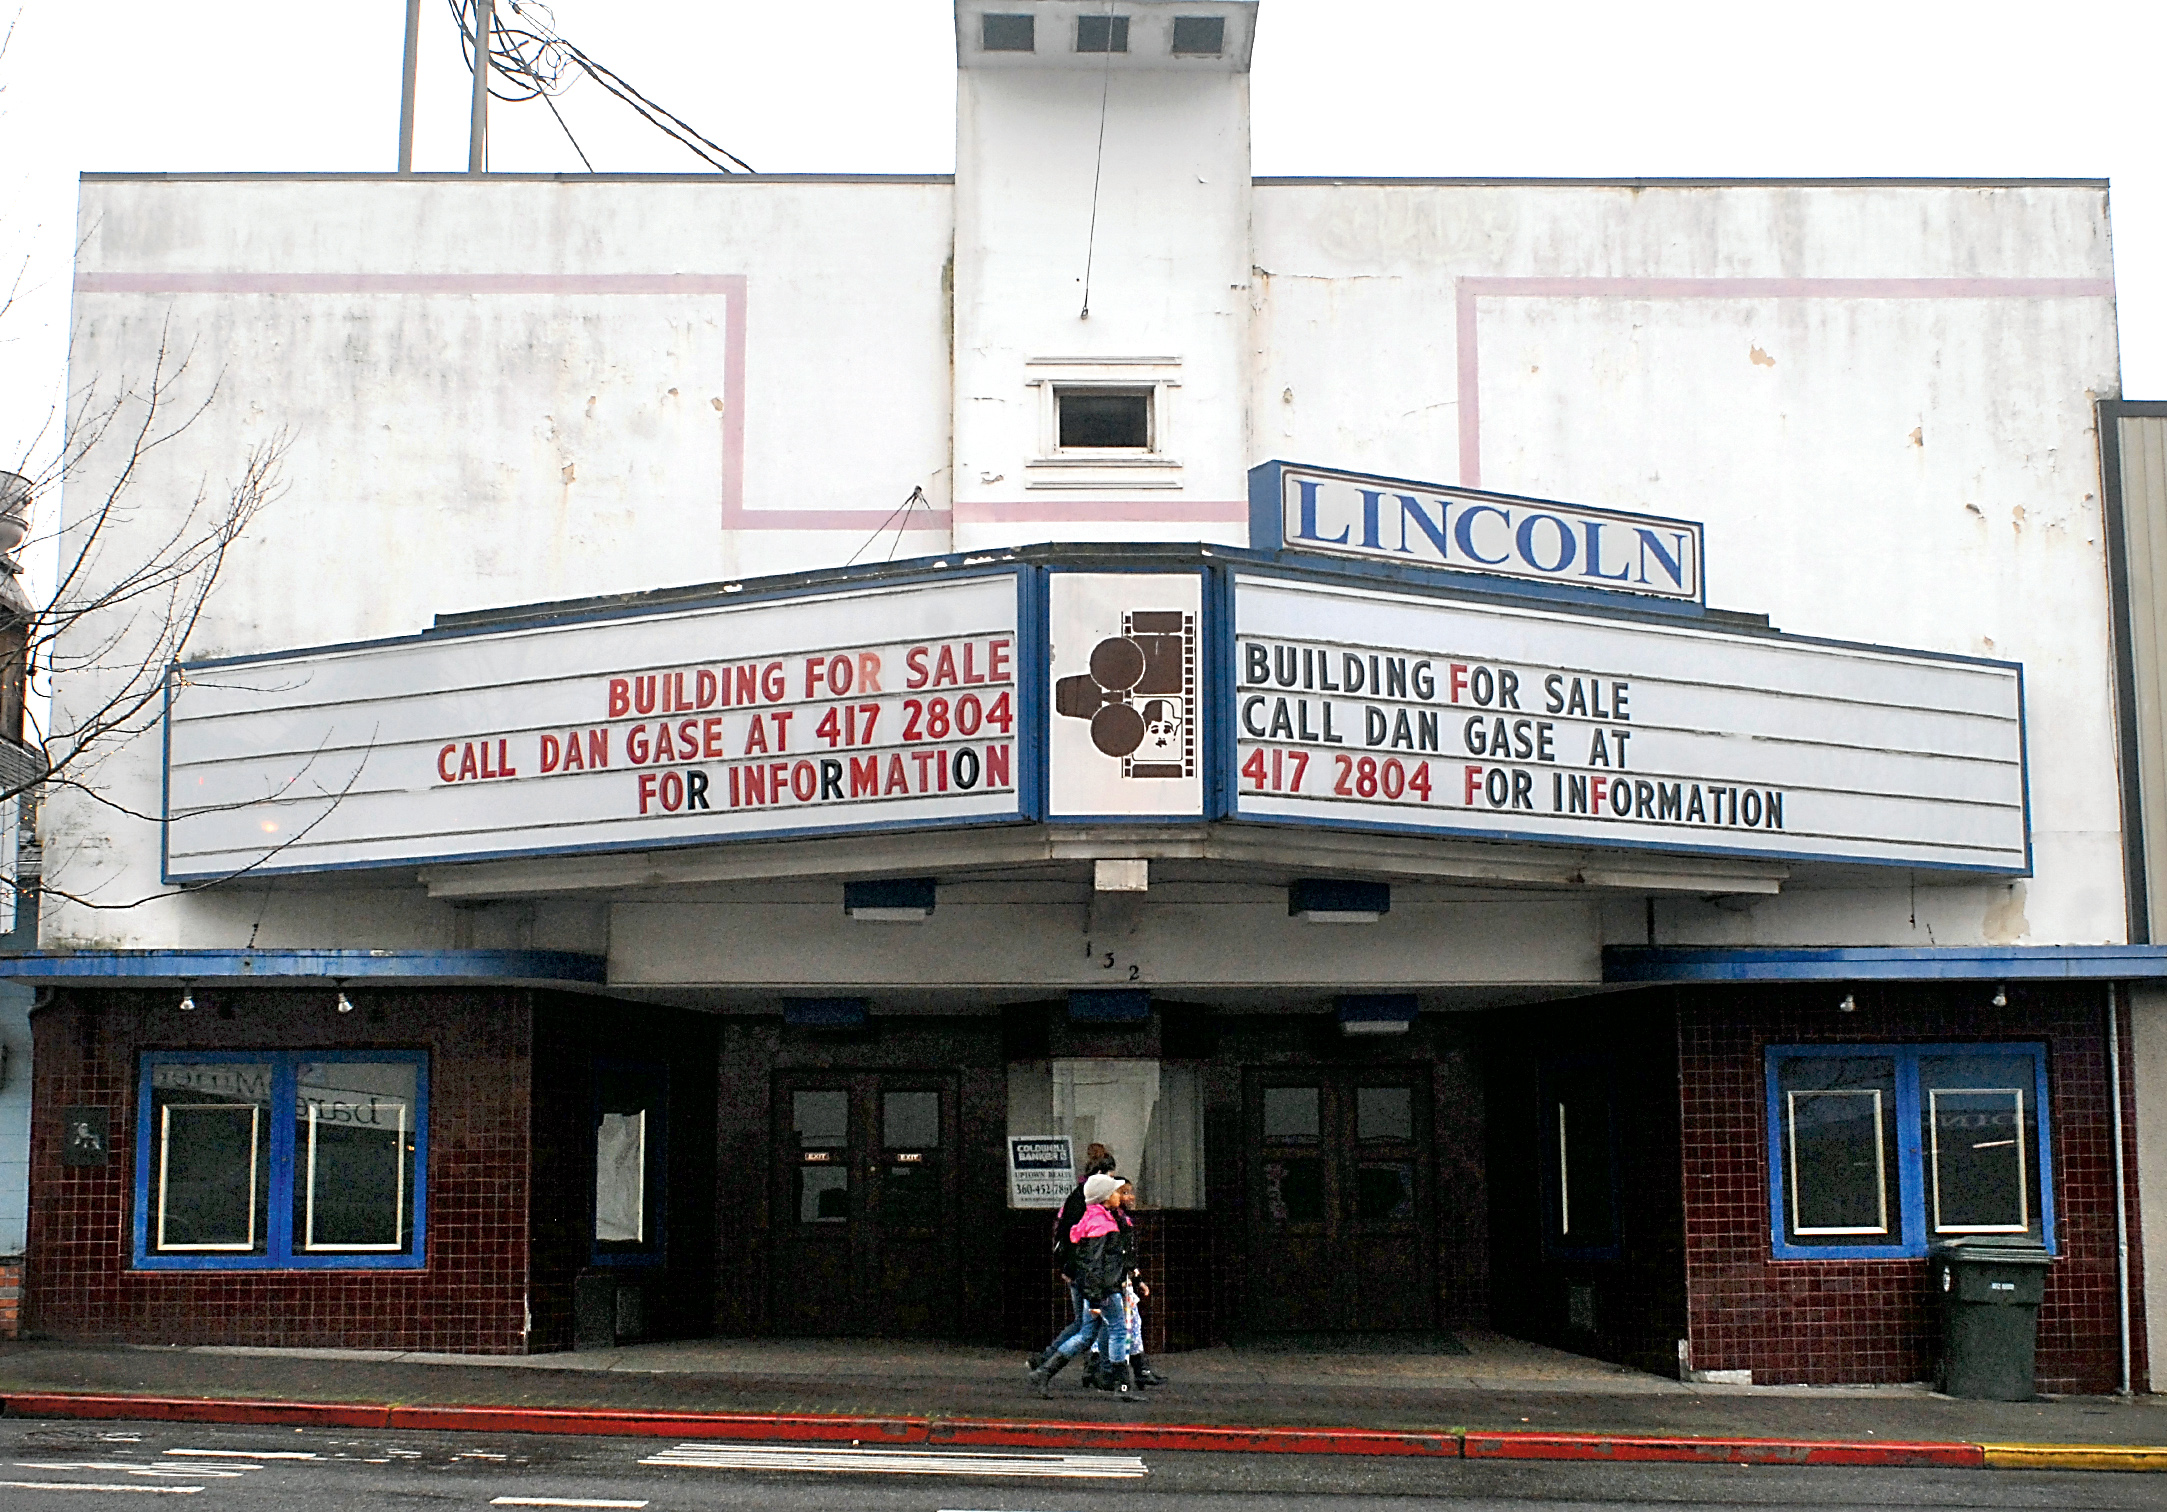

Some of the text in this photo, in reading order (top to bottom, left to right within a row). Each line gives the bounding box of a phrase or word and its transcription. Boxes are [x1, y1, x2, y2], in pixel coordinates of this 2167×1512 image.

[1291, 479, 1688, 590] LINCOLN
[608, 638, 1012, 718] BUILDING FOR SALE
[1244, 642, 1631, 721] BUILDING FOR SALE
[437, 691, 1013, 783] CALL DAN GASE AT 417 2804
[1241, 695, 1631, 769] CALL DAN GASE AT
[638, 744, 1011, 815] FOR INFORMATION
[1241, 747, 1783, 829] 417 2804 FOR INFORMATION
[1017, 1144, 1066, 1152] COLDWELL
[1018, 1152, 1058, 1161] BANKER
